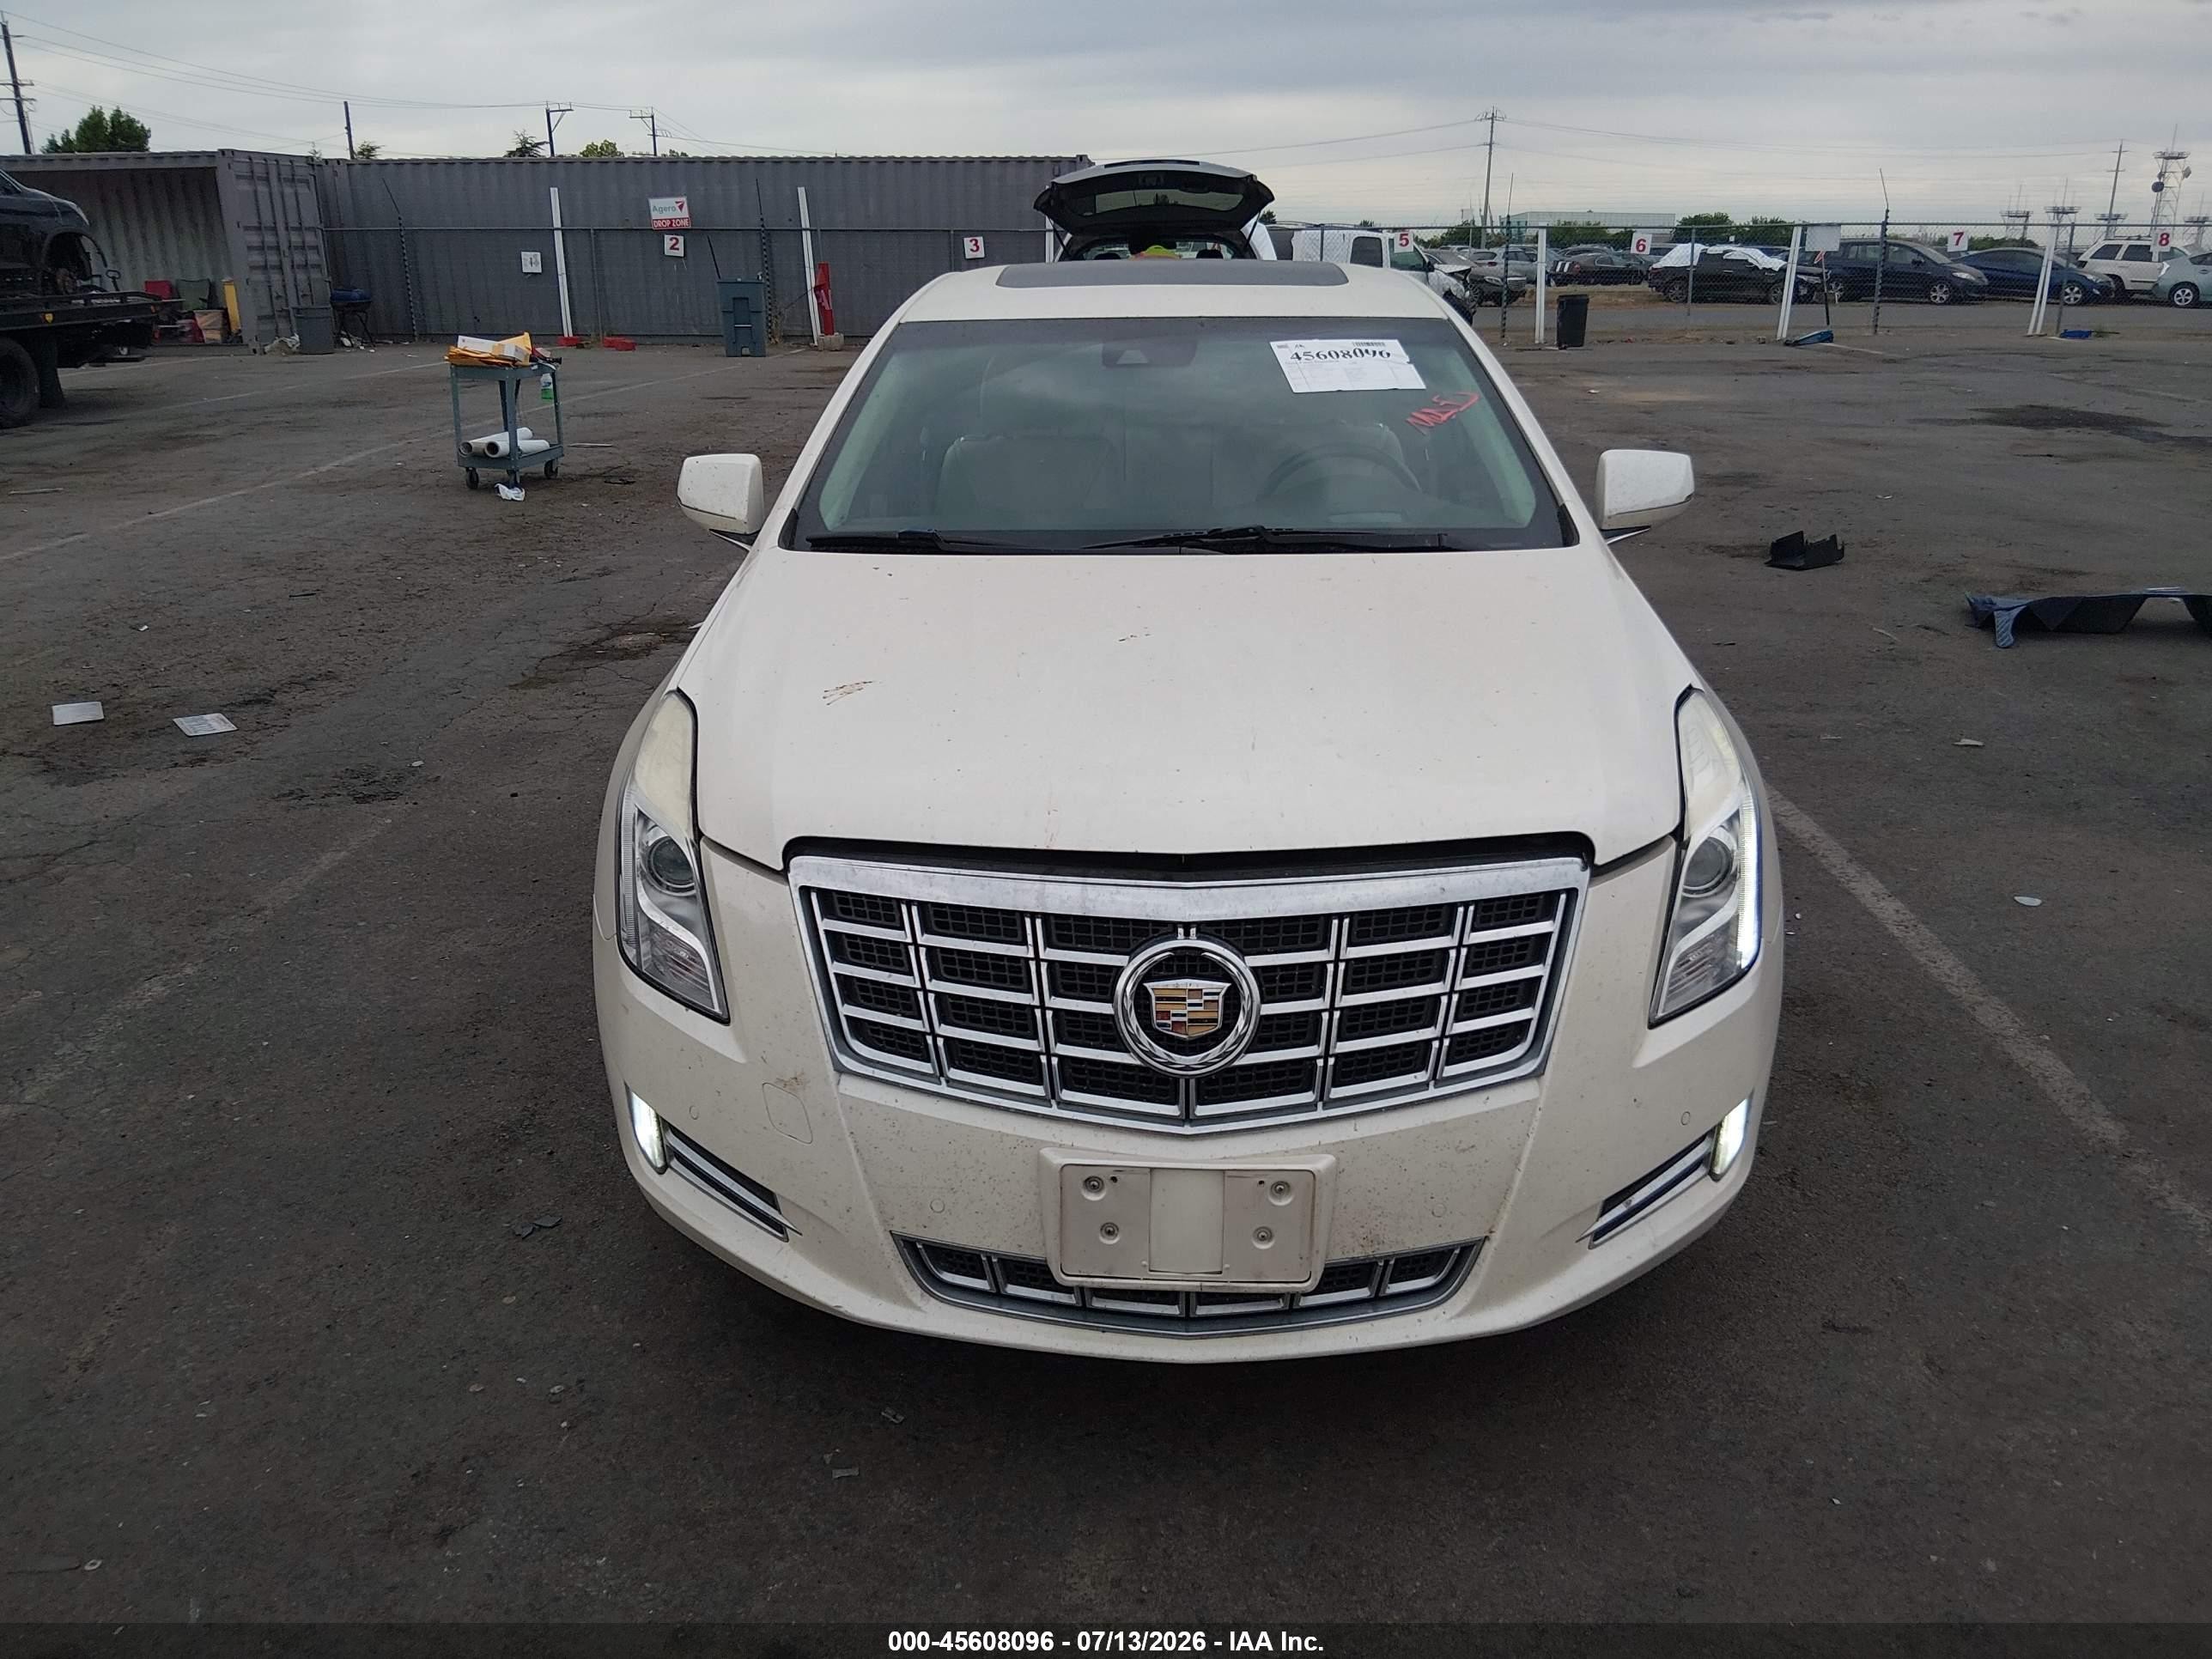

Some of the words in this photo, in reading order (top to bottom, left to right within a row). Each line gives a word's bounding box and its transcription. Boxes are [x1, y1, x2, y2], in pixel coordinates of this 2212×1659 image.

[653, 220, 671, 228] DROP
[669, 236, 680, 252] 2
[969, 238, 980, 252] 3
[1399, 233, 1410, 247] 5
[1635, 238, 1647, 253] 6
[1953, 232, 1965, 246] 7
[2158, 233, 2170, 247] 8
